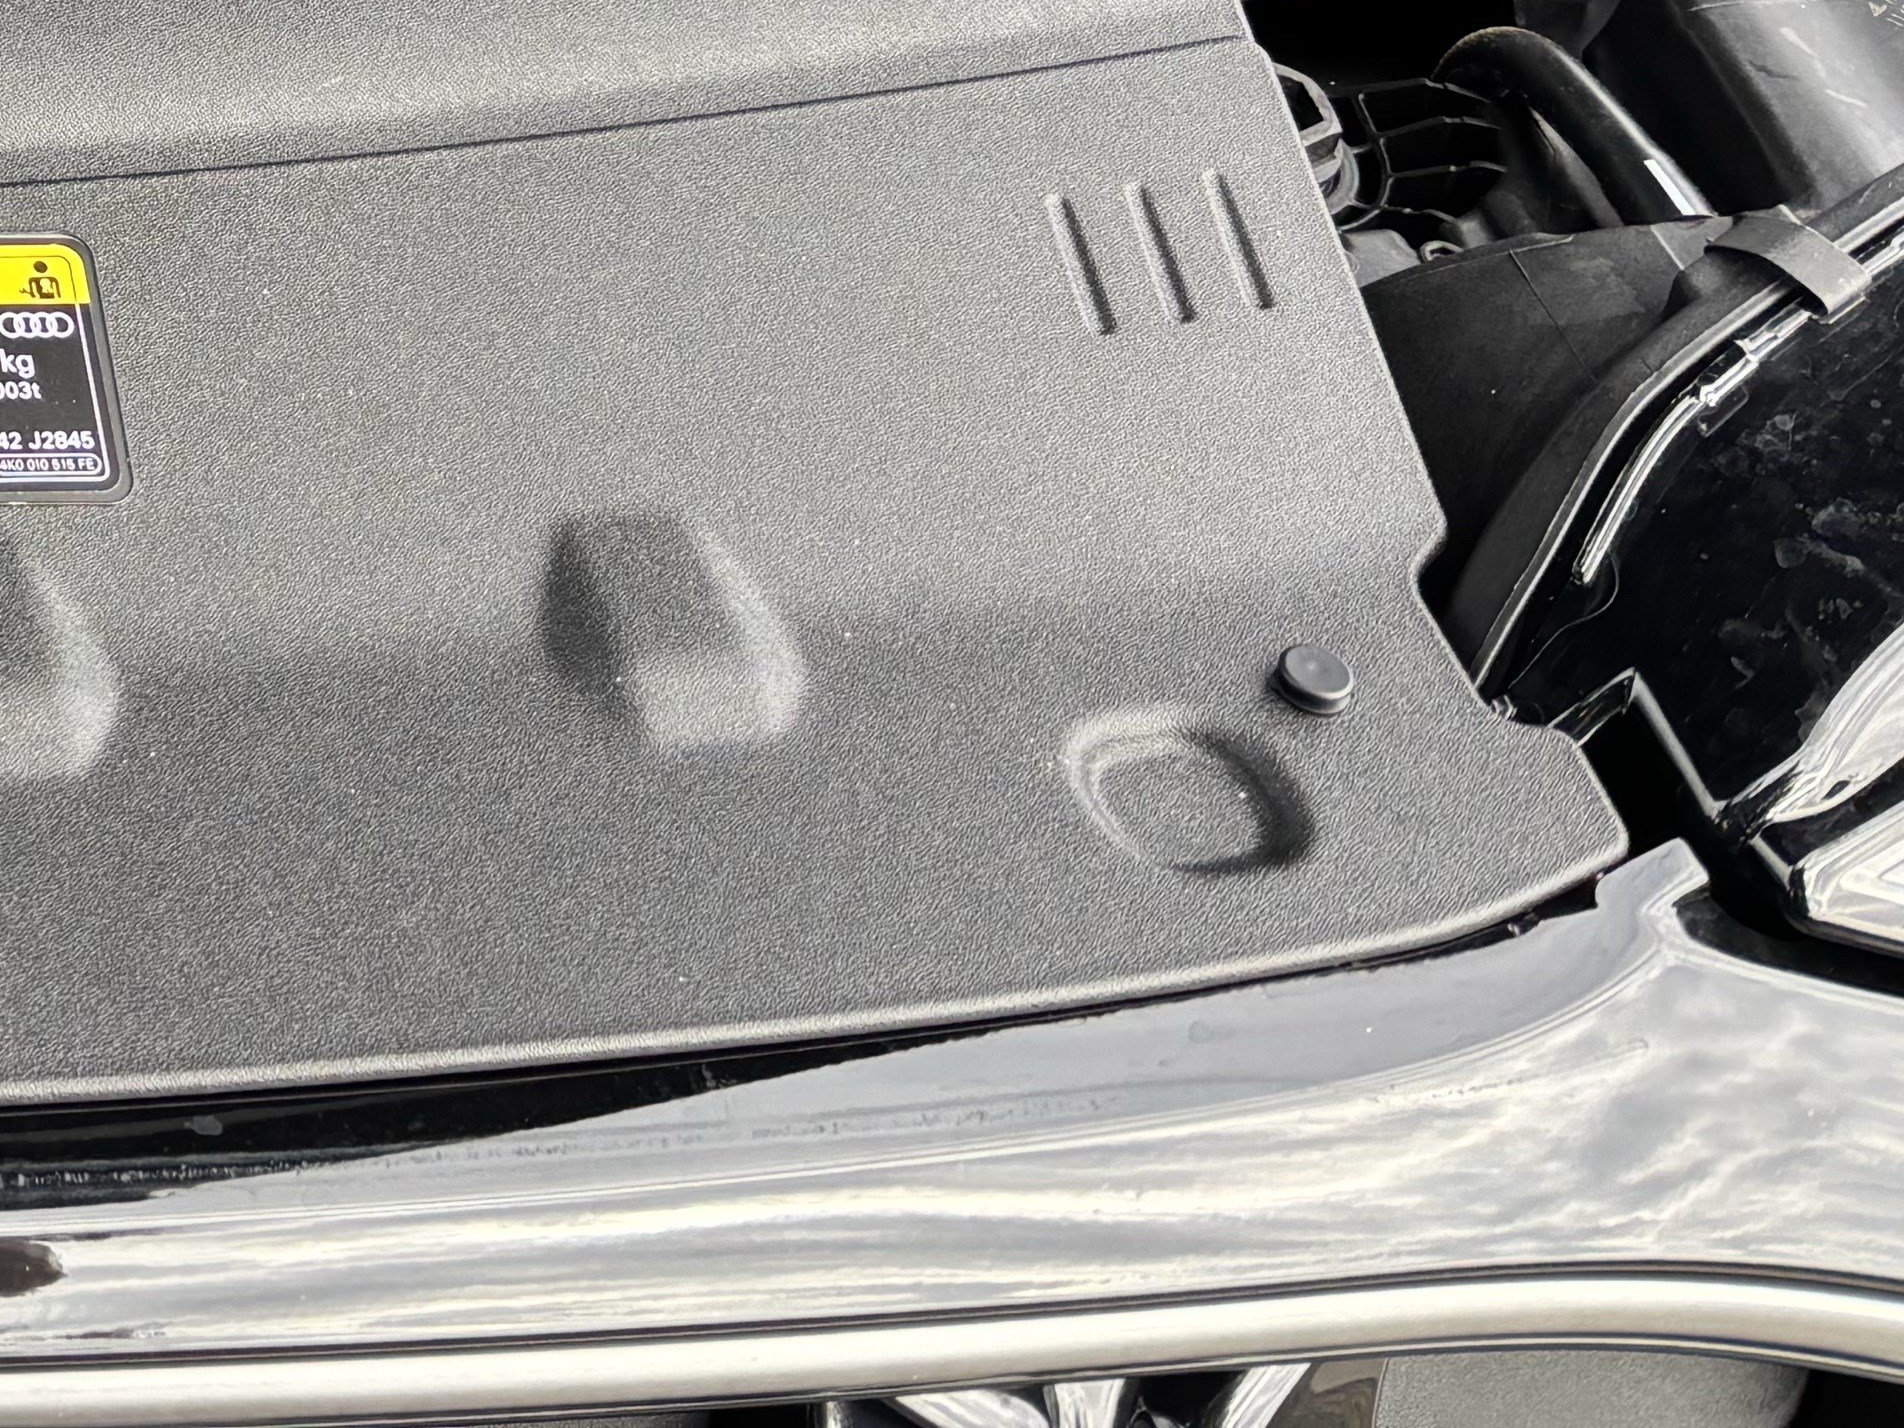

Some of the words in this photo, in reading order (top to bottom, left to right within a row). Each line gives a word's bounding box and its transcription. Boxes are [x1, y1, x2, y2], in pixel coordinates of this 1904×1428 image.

[28, 430, 96, 451] J2845
[26, 459, 49, 471] 010
[51, 459, 76, 471] 515
[78, 459, 96, 471] FE
